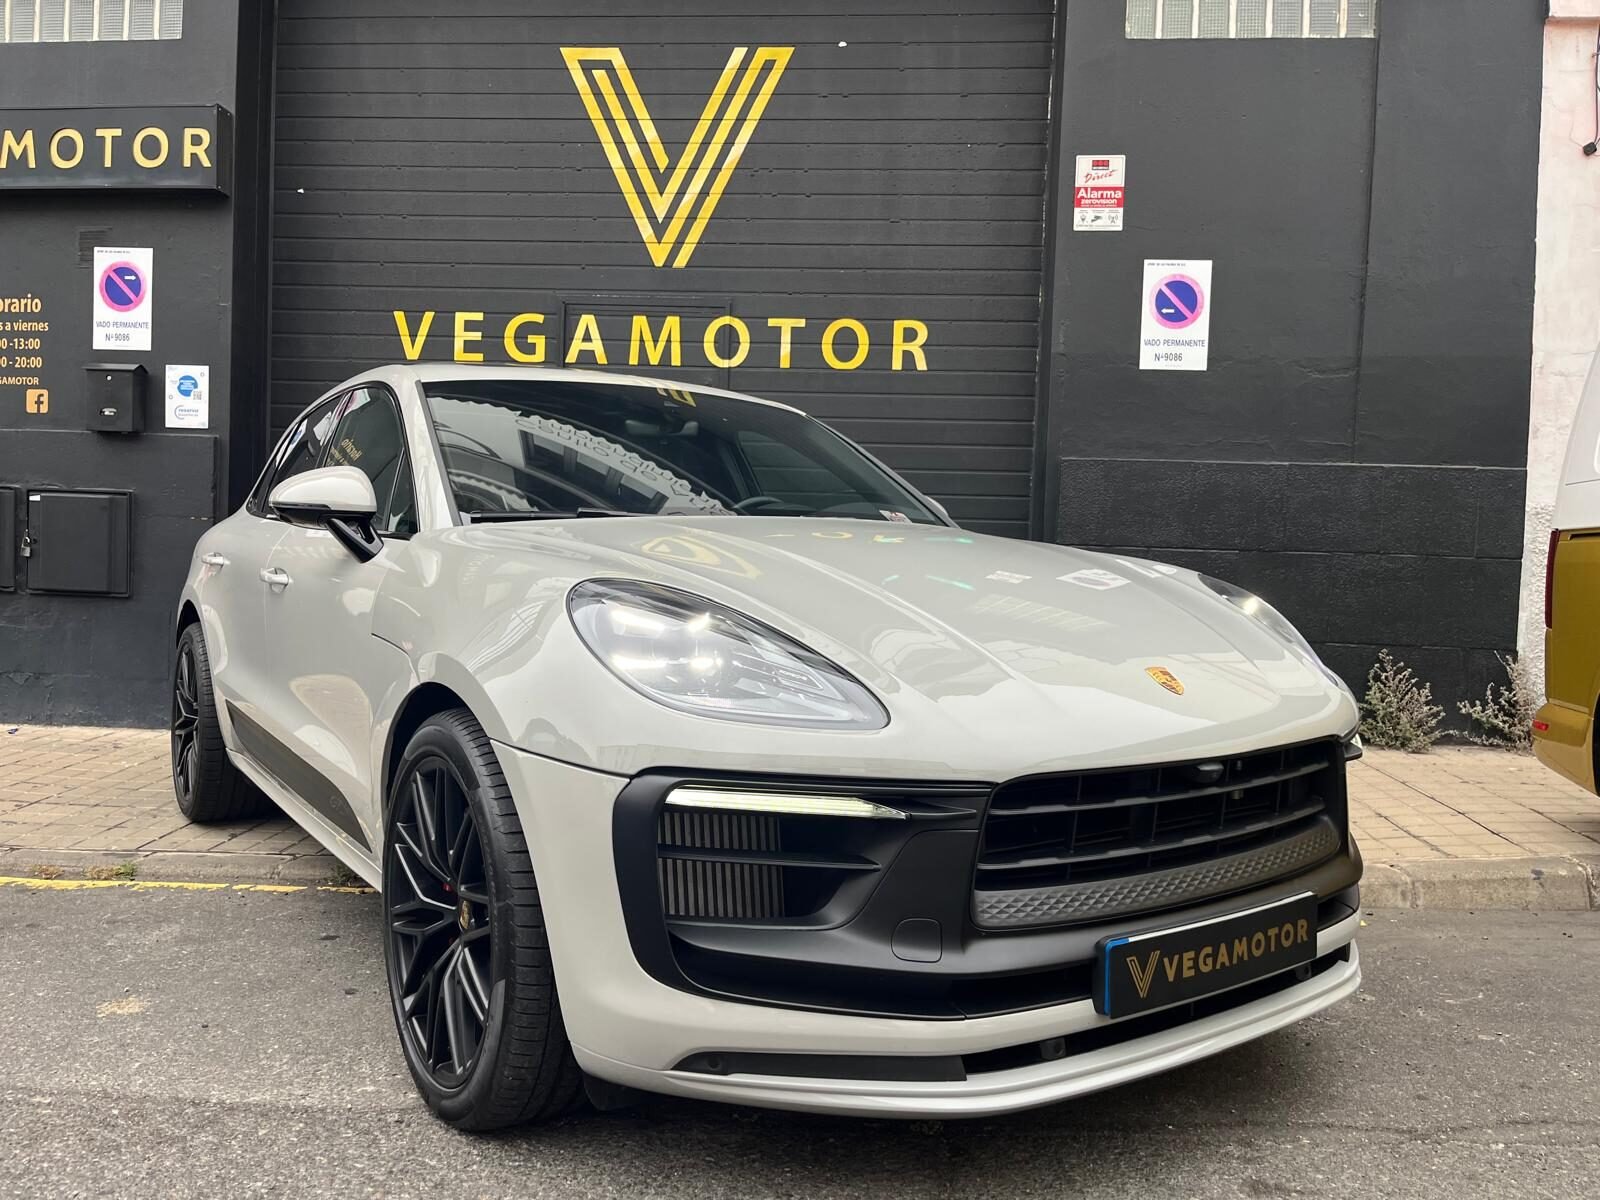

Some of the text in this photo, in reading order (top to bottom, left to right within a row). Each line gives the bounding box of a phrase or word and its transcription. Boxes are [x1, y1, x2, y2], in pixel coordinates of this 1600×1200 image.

[0, 126, 212, 169] MOTOR
[1077, 187, 1122, 199] Alarma
[5, 322, 11, 331] a
[13, 319, 49, 331] viernes
[96, 320, 150, 330] VADO PERMANENTE
[393, 310, 930, 371] VEGAMOTOR
[1143, 339, 1206, 348] VADO PERMANENTE
[14, 357, 42, 368] 20:00
[1163, 918, 1309, 982] VEGAMOTOR
